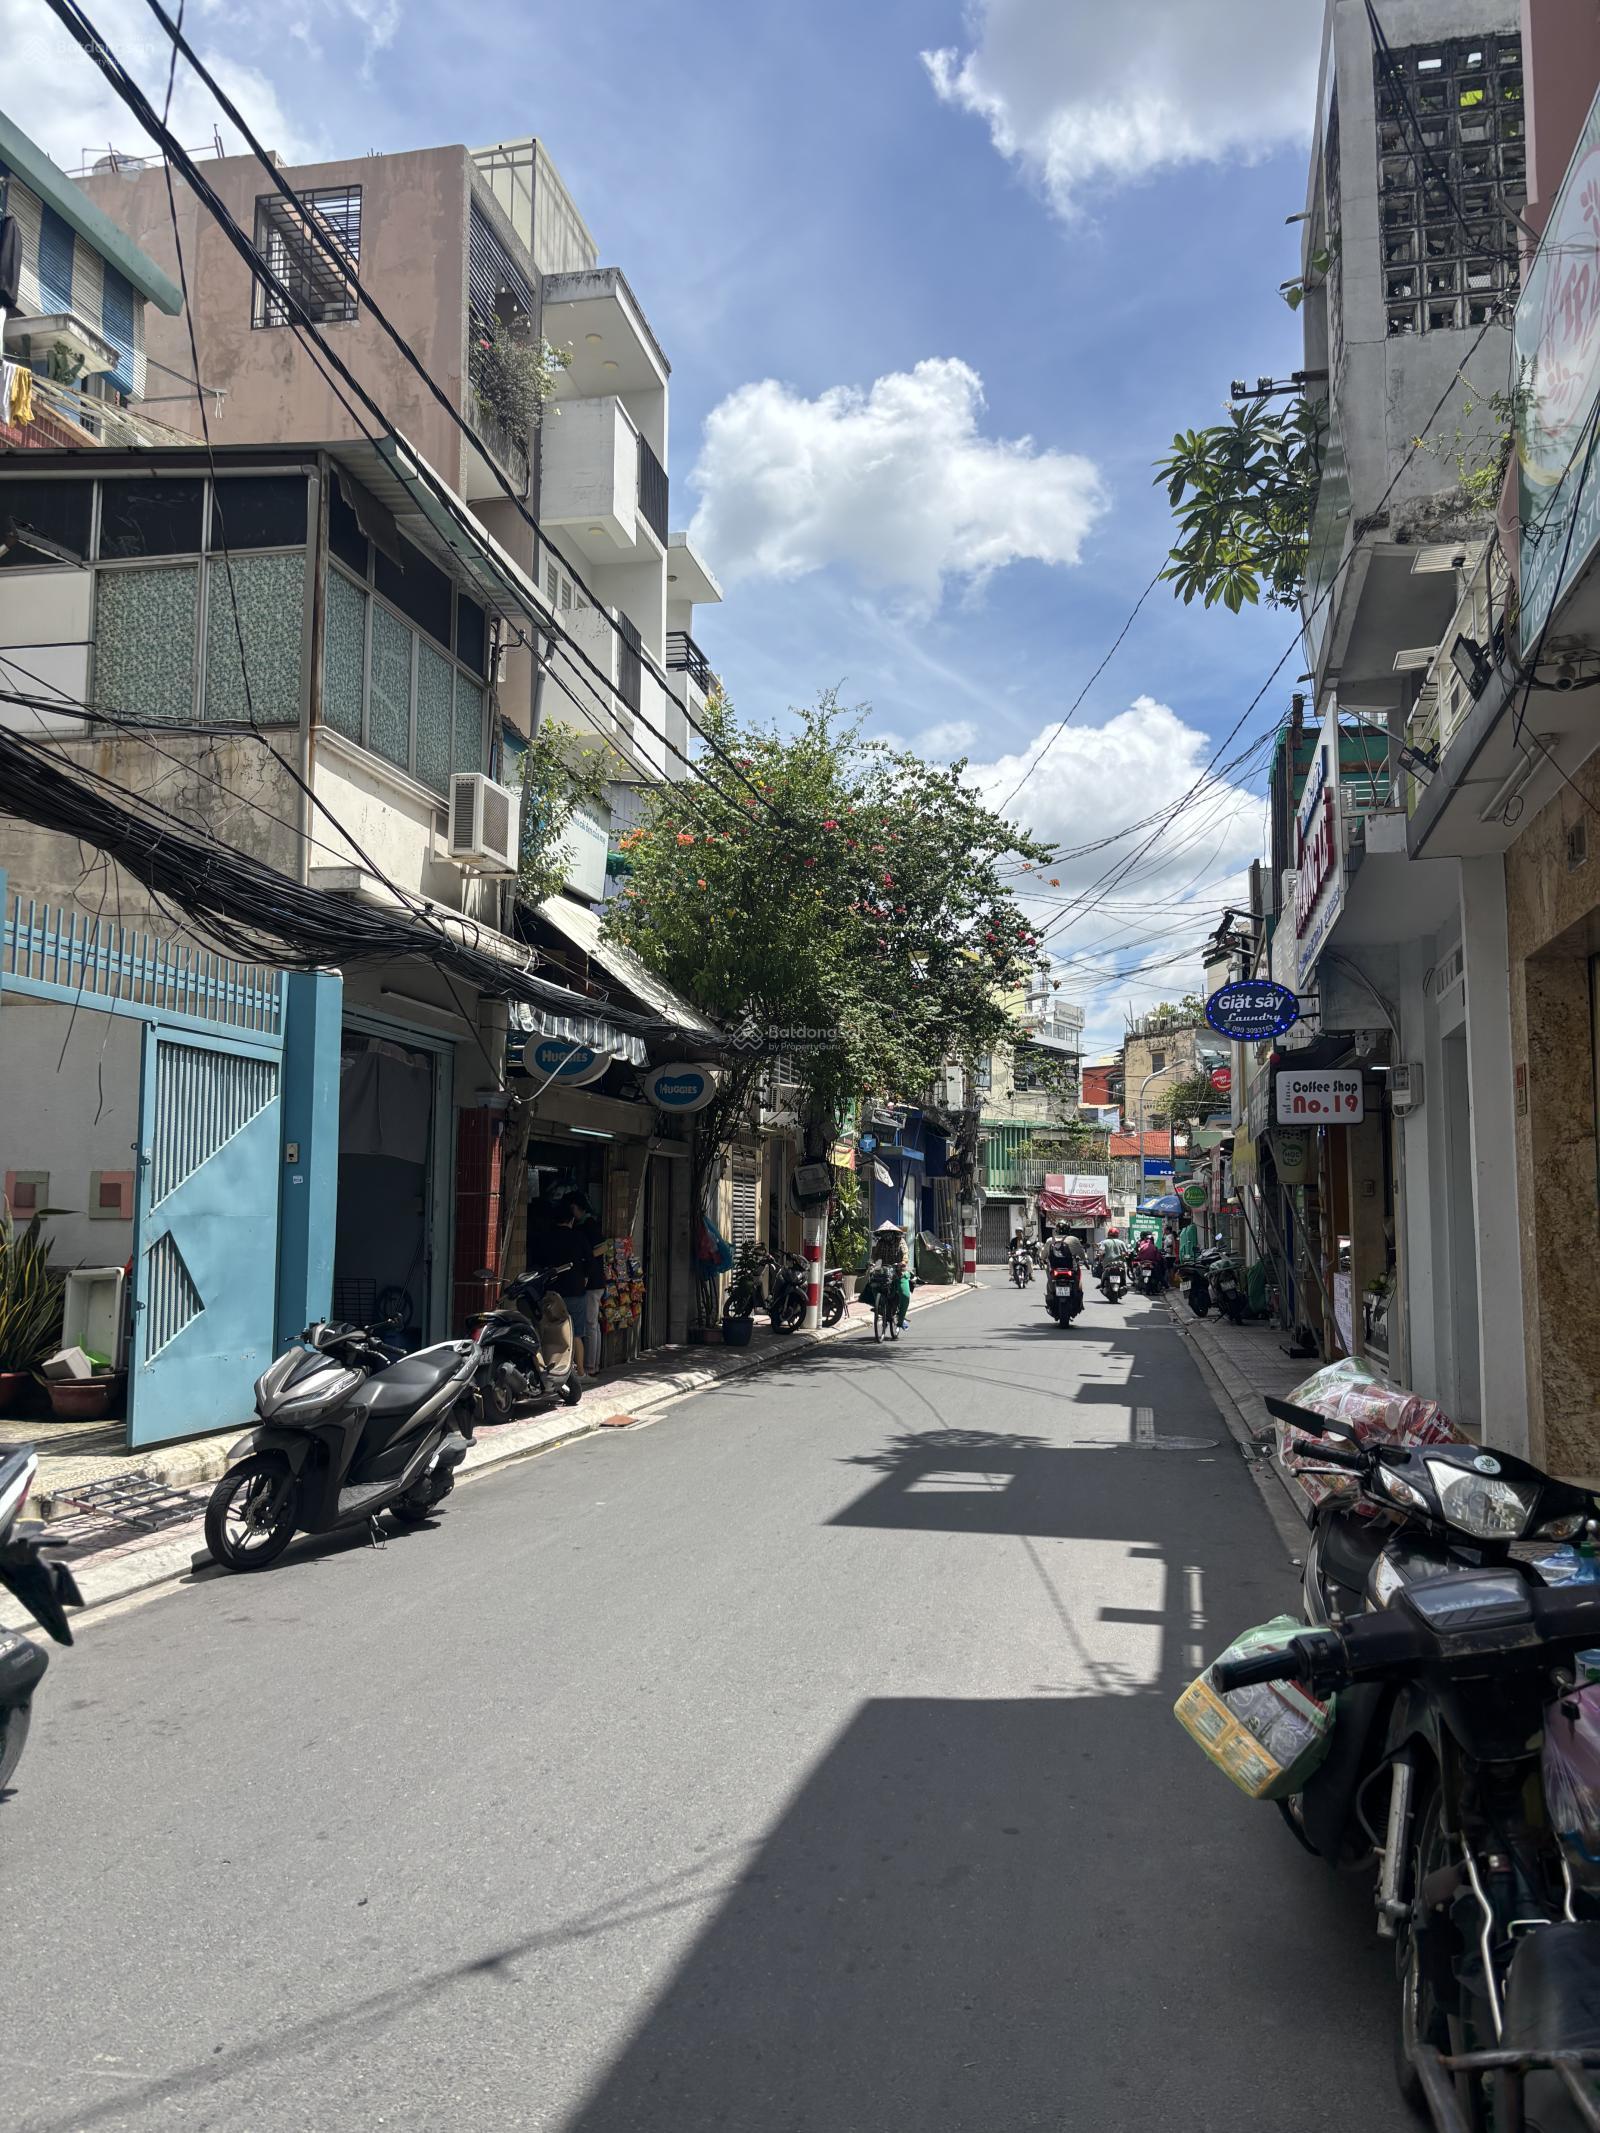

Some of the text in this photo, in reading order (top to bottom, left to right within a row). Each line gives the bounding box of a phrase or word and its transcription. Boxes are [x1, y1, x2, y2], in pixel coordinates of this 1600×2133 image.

[1218, 992, 1285, 1012] Giặt sấy
[1224, 1012, 1282, 1023] Laundry
[1292, 1080, 1358, 1094] Coffee Shop
